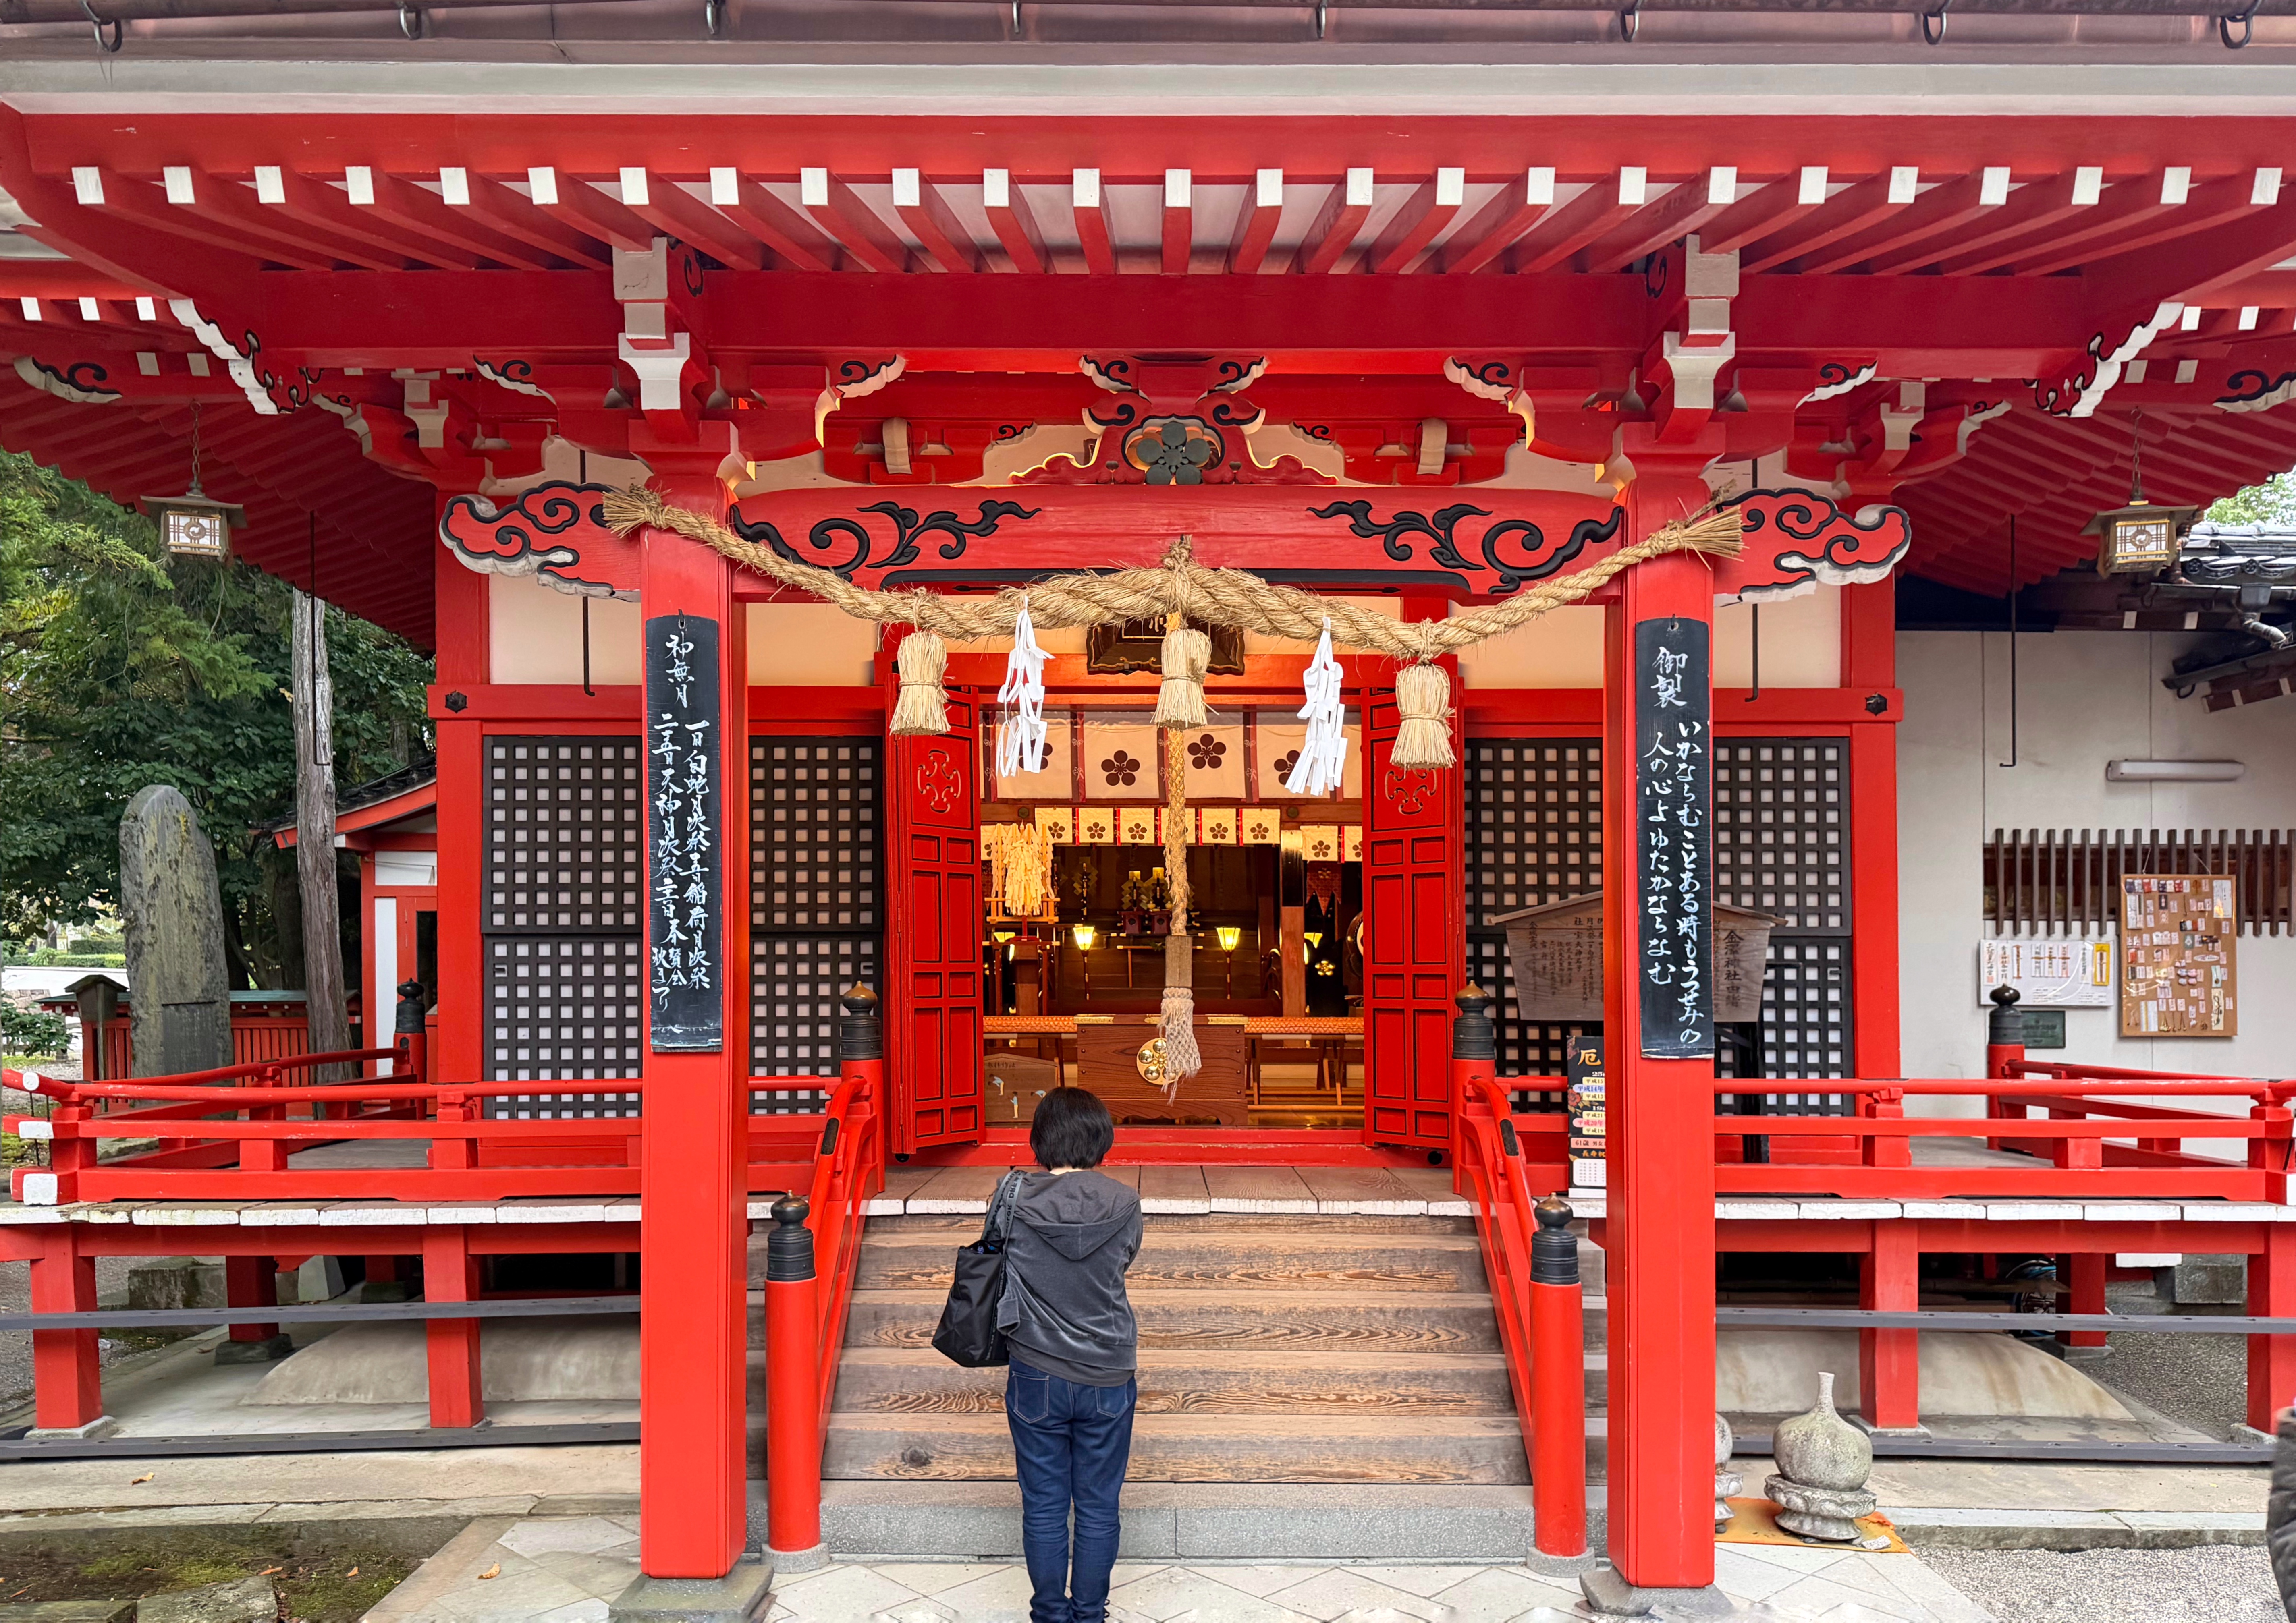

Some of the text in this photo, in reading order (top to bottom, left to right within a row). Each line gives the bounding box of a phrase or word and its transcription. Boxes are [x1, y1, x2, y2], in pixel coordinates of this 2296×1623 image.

[665, 631, 695, 708] 神無月
[1650, 646, 1688, 708] 御製
[1578, 1049, 1602, 1066] 厄
